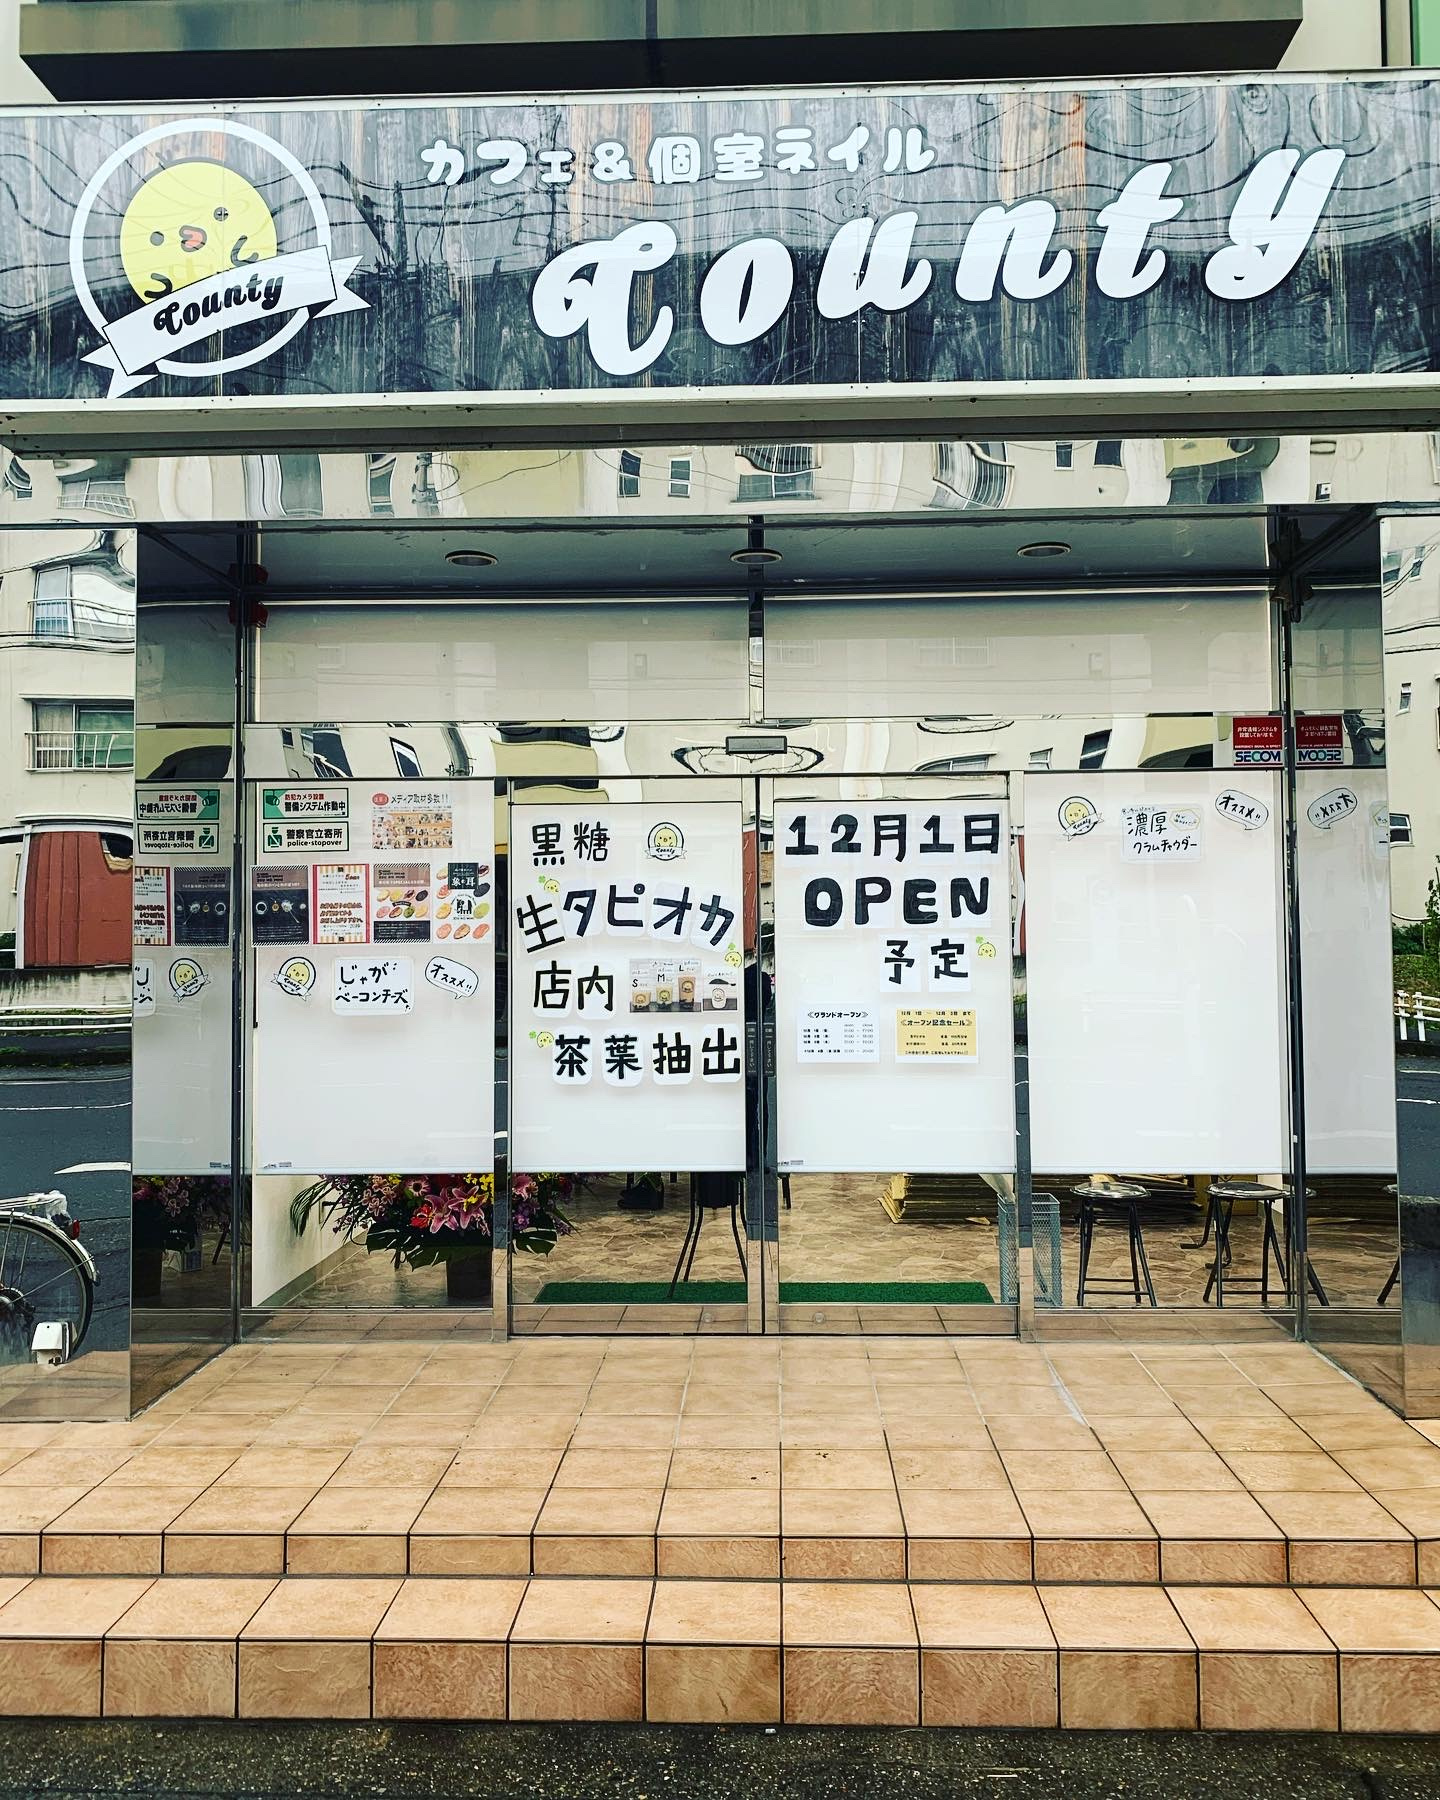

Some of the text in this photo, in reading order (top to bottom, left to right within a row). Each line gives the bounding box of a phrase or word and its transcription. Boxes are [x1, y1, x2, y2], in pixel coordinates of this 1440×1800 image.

[531, 148, 1345, 377] County
[152, 271, 285, 337] County
[1235, 751, 1281, 762] SECOM
[284, 793, 325, 801] 防犯カメラ設置
[284, 801, 346, 812] 警備システム作動中
[286, 828, 343, 839] 警察官立寄所
[532, 820, 610, 867] 黒糖
[785, 813, 999, 862] 12月1日
[1126, 811, 1168, 837] 濃厚
[1133, 836, 1198, 854] クラムチャウダー
[516, 883, 735, 953] 生タピオカ
[804, 876, 989, 927] OPEN
[340, 962, 388, 985] じゃが
[884, 938, 968, 985] 予定
[335, 988, 408, 1004] ベーコンチーズ
[533, 960, 614, 1012] 店内
[554, 1027, 741, 1079] 茶葉抽出
